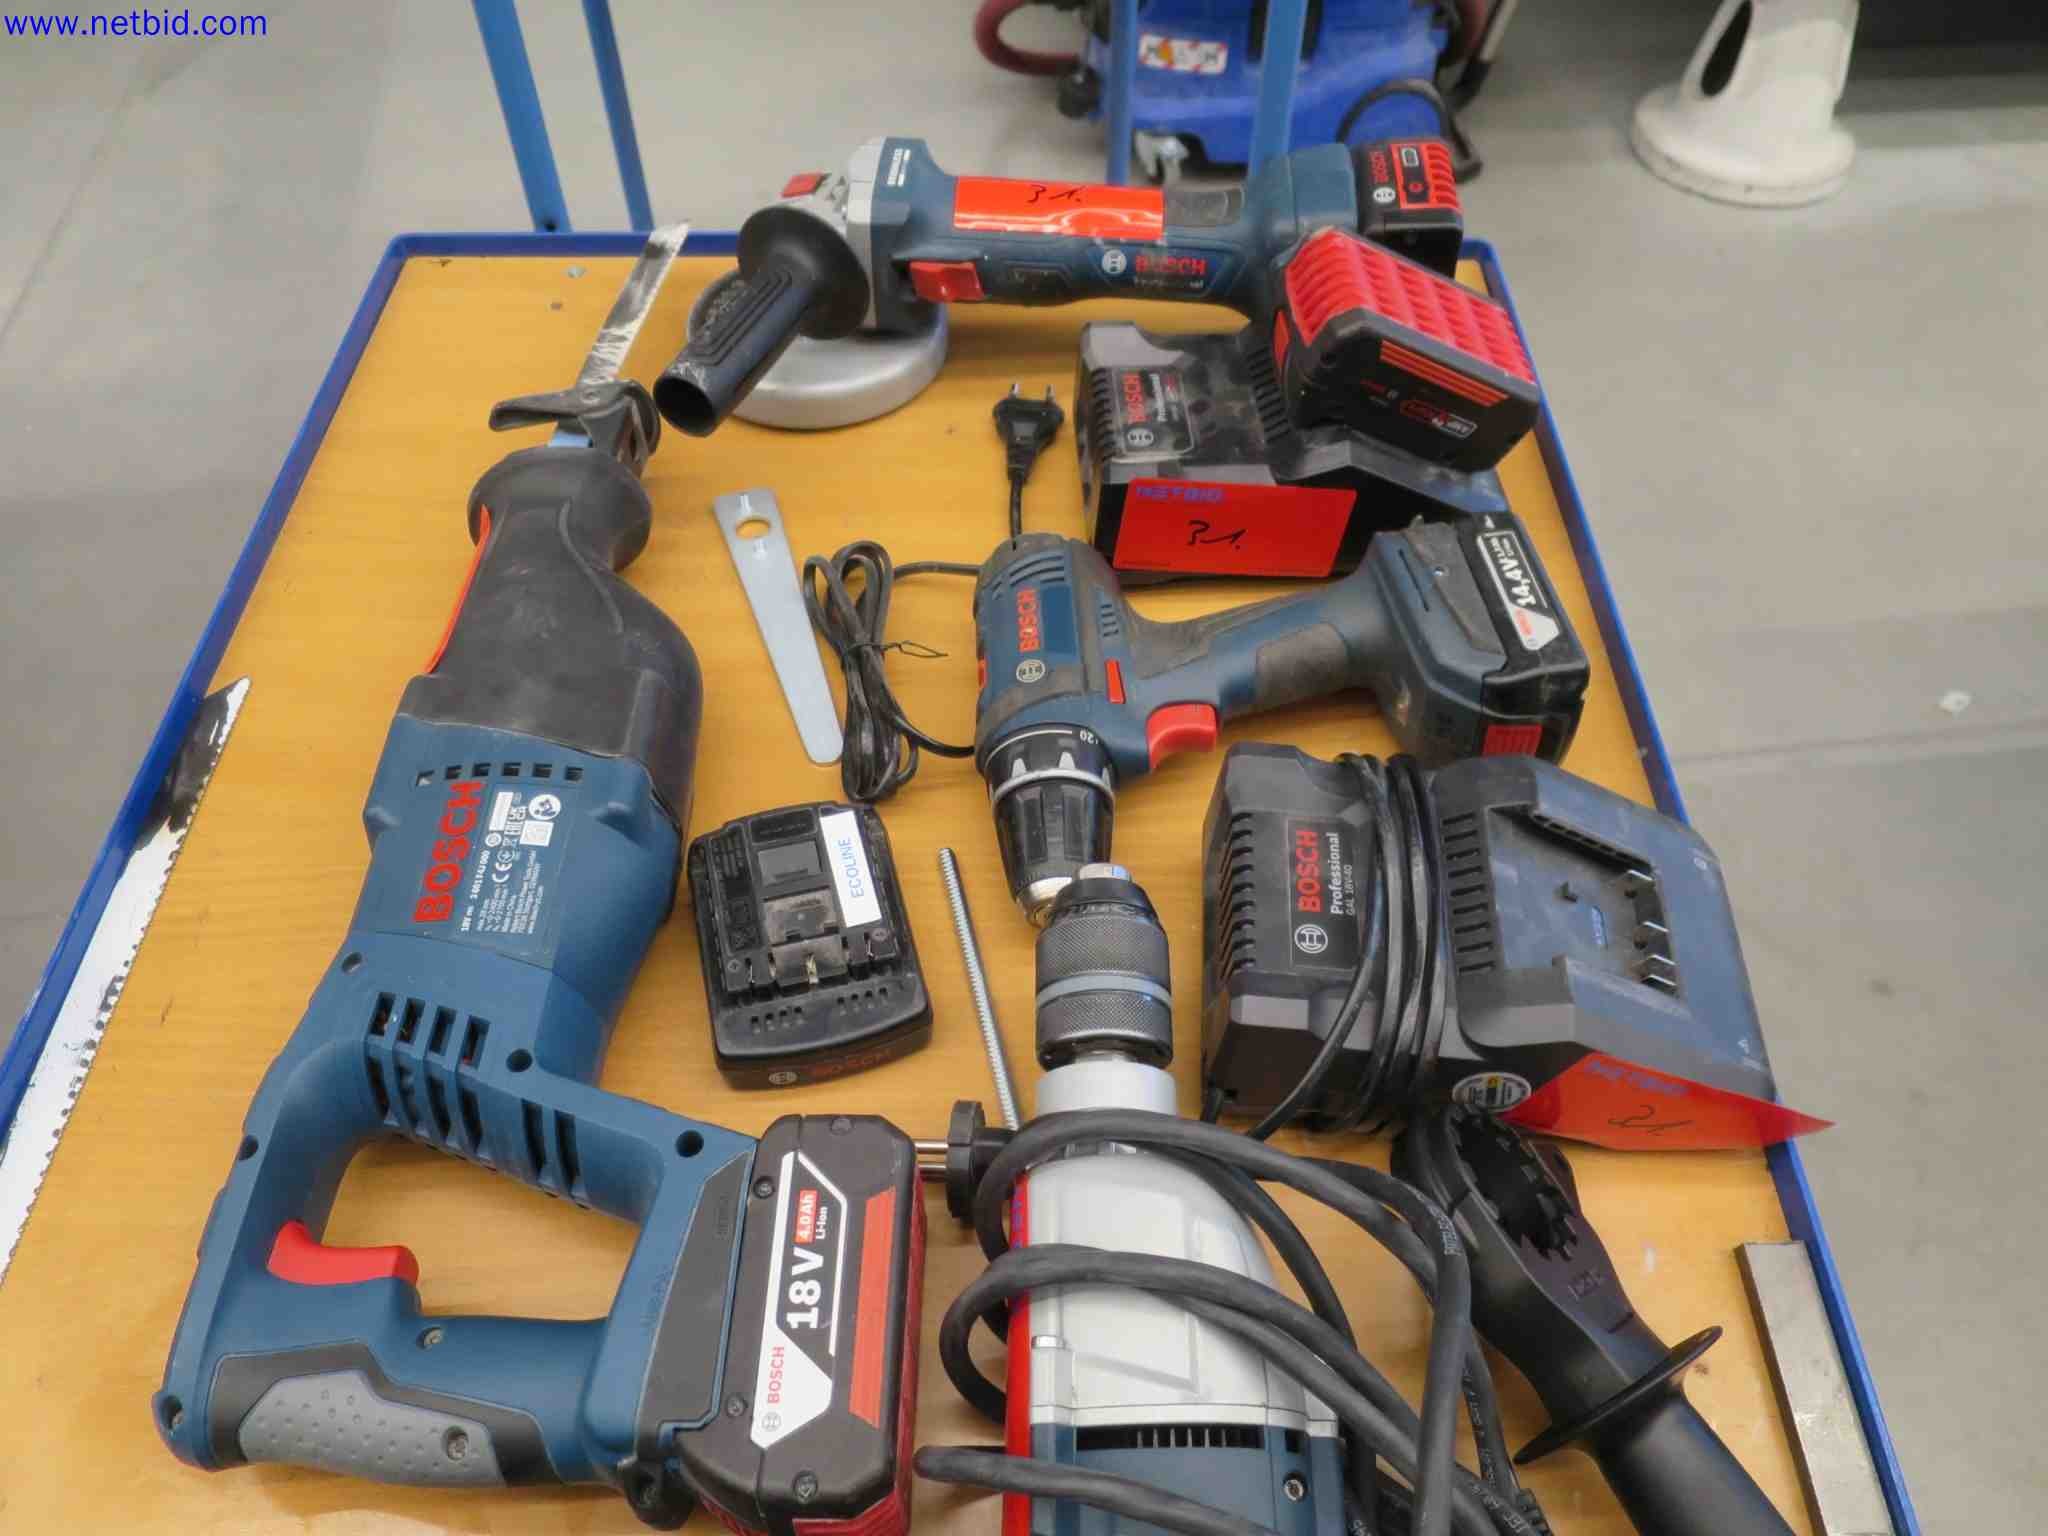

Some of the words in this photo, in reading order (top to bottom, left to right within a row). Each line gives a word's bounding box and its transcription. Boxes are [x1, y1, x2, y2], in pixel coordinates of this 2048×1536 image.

[1016, 587, 1041, 653] BOSCH
[412, 781, 487, 923] BOSCH
[837, 838, 864, 899] ECOLINE
[1296, 829, 1322, 913] BOSCH
[1326, 832, 1344, 915] Professional
[767, 1346, 785, 1404] BOSCH
